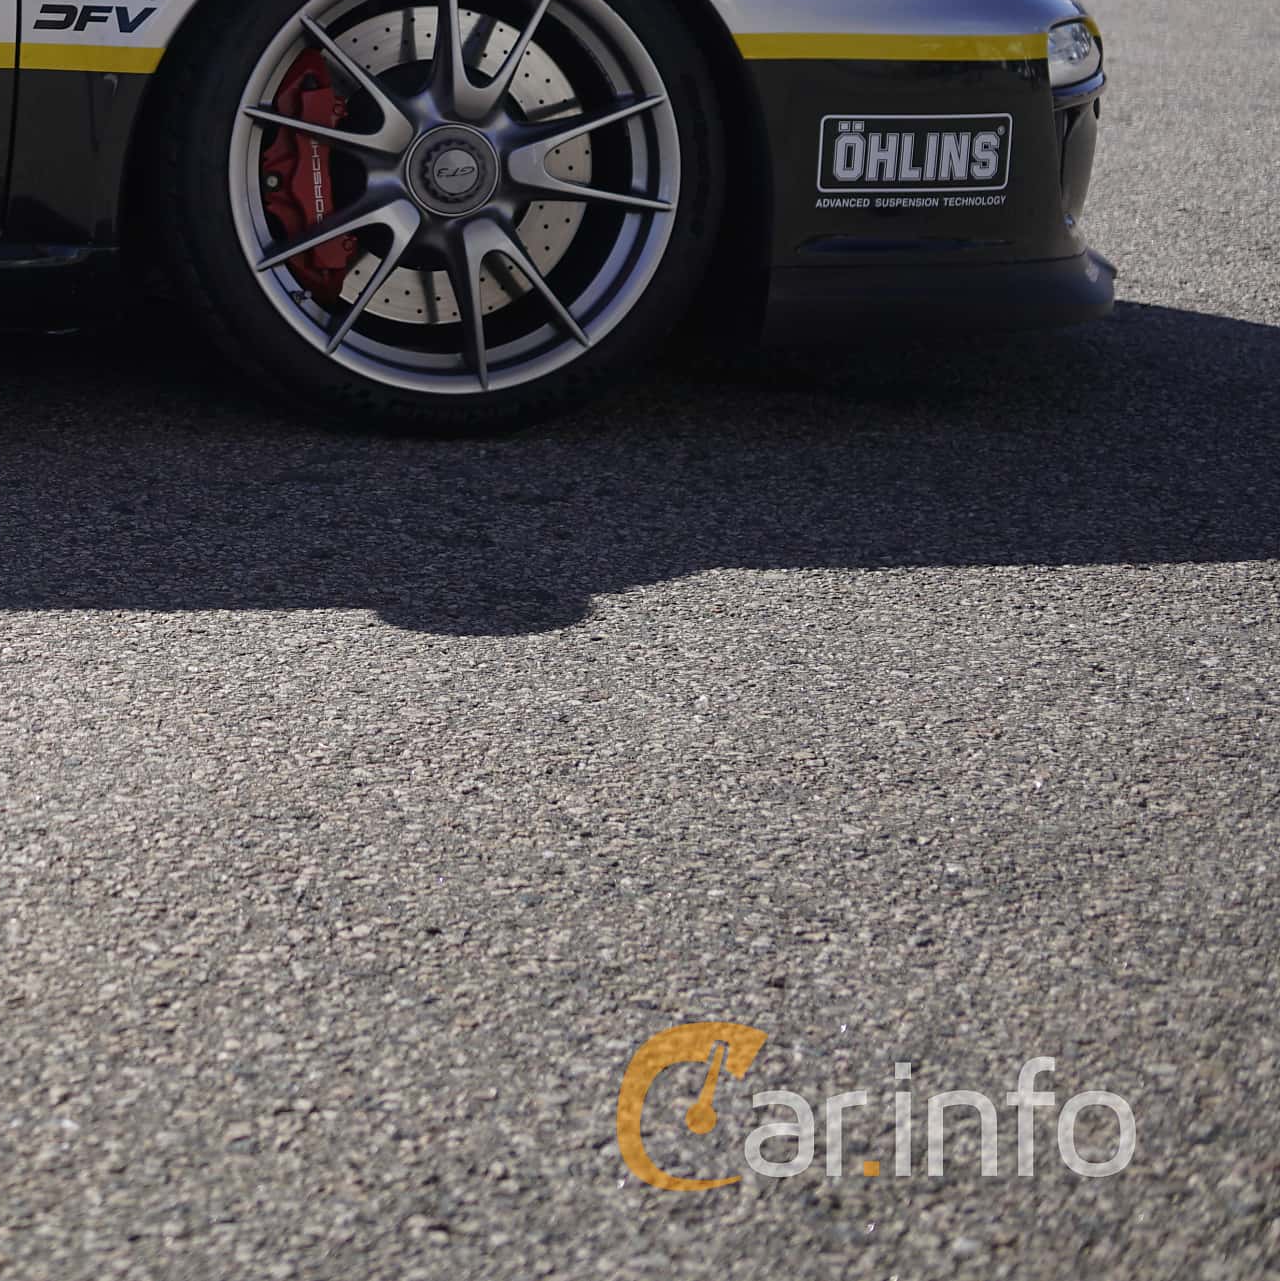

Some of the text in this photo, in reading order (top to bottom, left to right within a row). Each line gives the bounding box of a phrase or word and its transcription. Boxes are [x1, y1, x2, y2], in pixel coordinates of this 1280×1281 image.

[33, 4, 157, 34] DFV
[833, 121, 1001, 182] ÖHLINS
[310, 139, 325, 225] PORSCH
[815, 195, 1007, 208] ADVANCED SUSPENSION TECHNOLOGY
